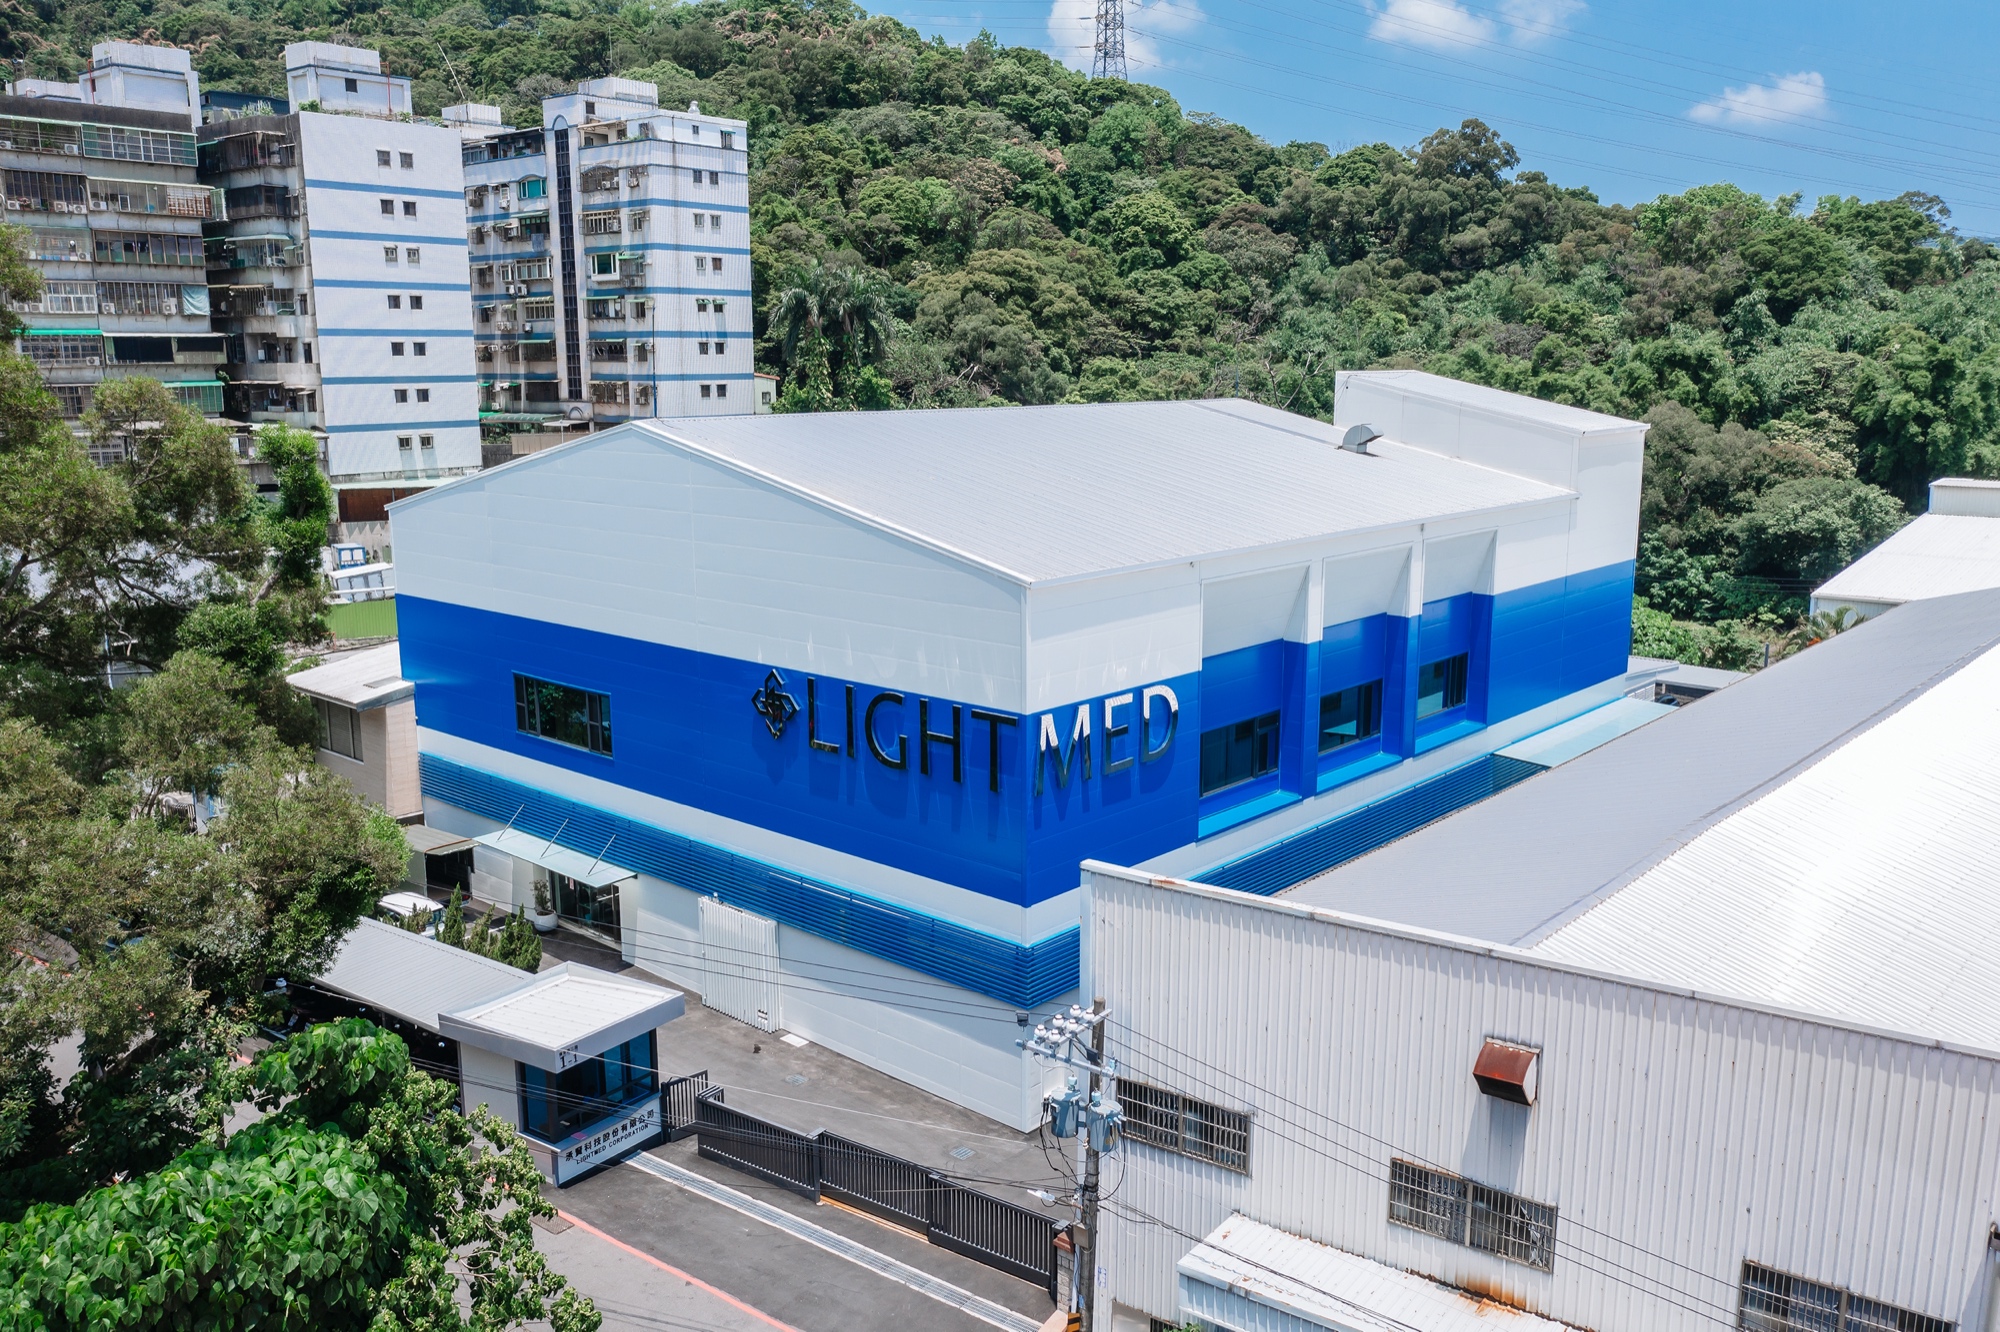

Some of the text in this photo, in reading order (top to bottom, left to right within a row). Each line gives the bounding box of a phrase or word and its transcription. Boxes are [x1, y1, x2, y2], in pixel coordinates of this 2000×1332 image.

[806, 676, 1019, 793] LIGHT
[1033, 684, 1179, 796] MED
[576, 1123, 649, 1165] LIGHTMED CORPORATION
